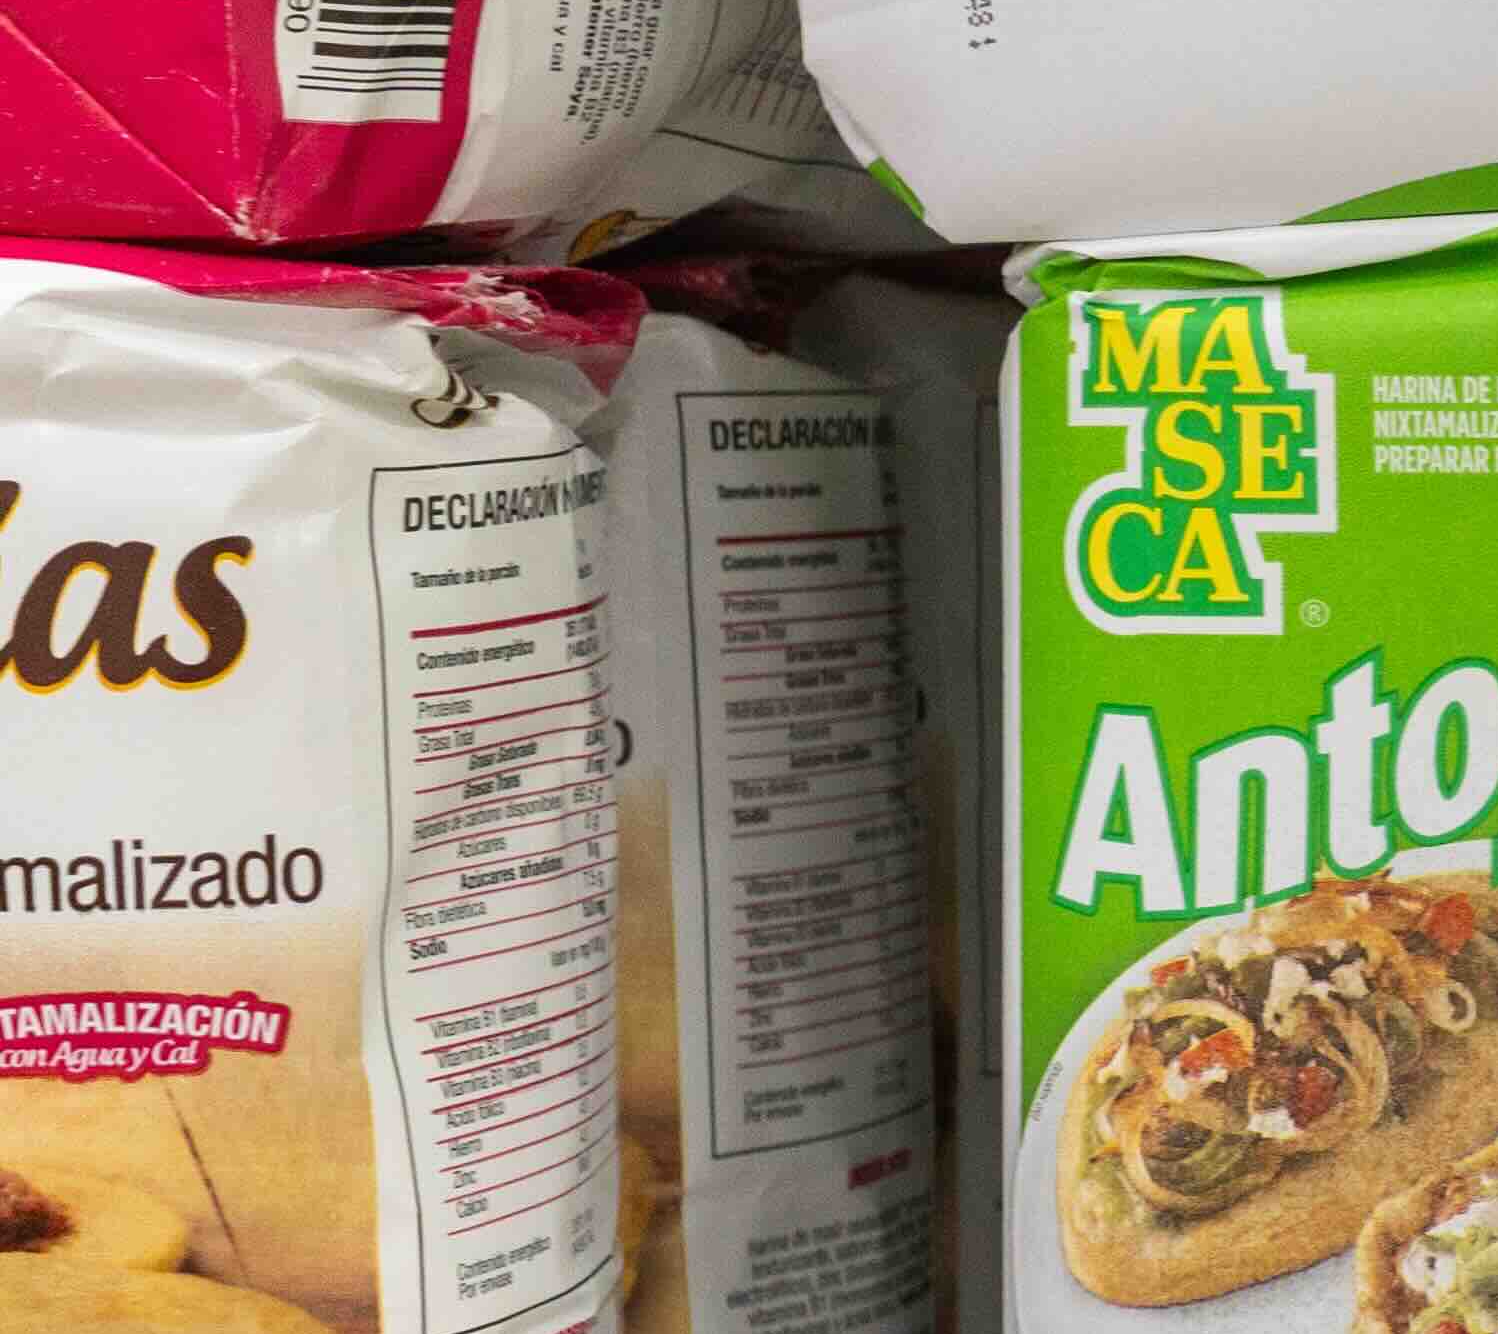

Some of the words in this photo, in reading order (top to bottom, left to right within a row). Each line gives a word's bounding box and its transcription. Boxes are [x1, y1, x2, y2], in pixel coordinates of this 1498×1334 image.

[1093, 305, 1273, 394] MA
[1372, 375, 1455, 404] HARINA
[1463, 375, 1490, 404] DE
[708, 411, 868, 451] DECLARACIÓN
[1153, 400, 1305, 500] SE
[1373, 445, 1489, 473] PREPARAR
[403, 477, 558, 533] DECLARACIÓN
[1087, 503, 1249, 603] CA
[48, 1040, 127, 1072] Agua
[125, 1047, 150, 1071] y
[151, 1039, 200, 1066] Cal
